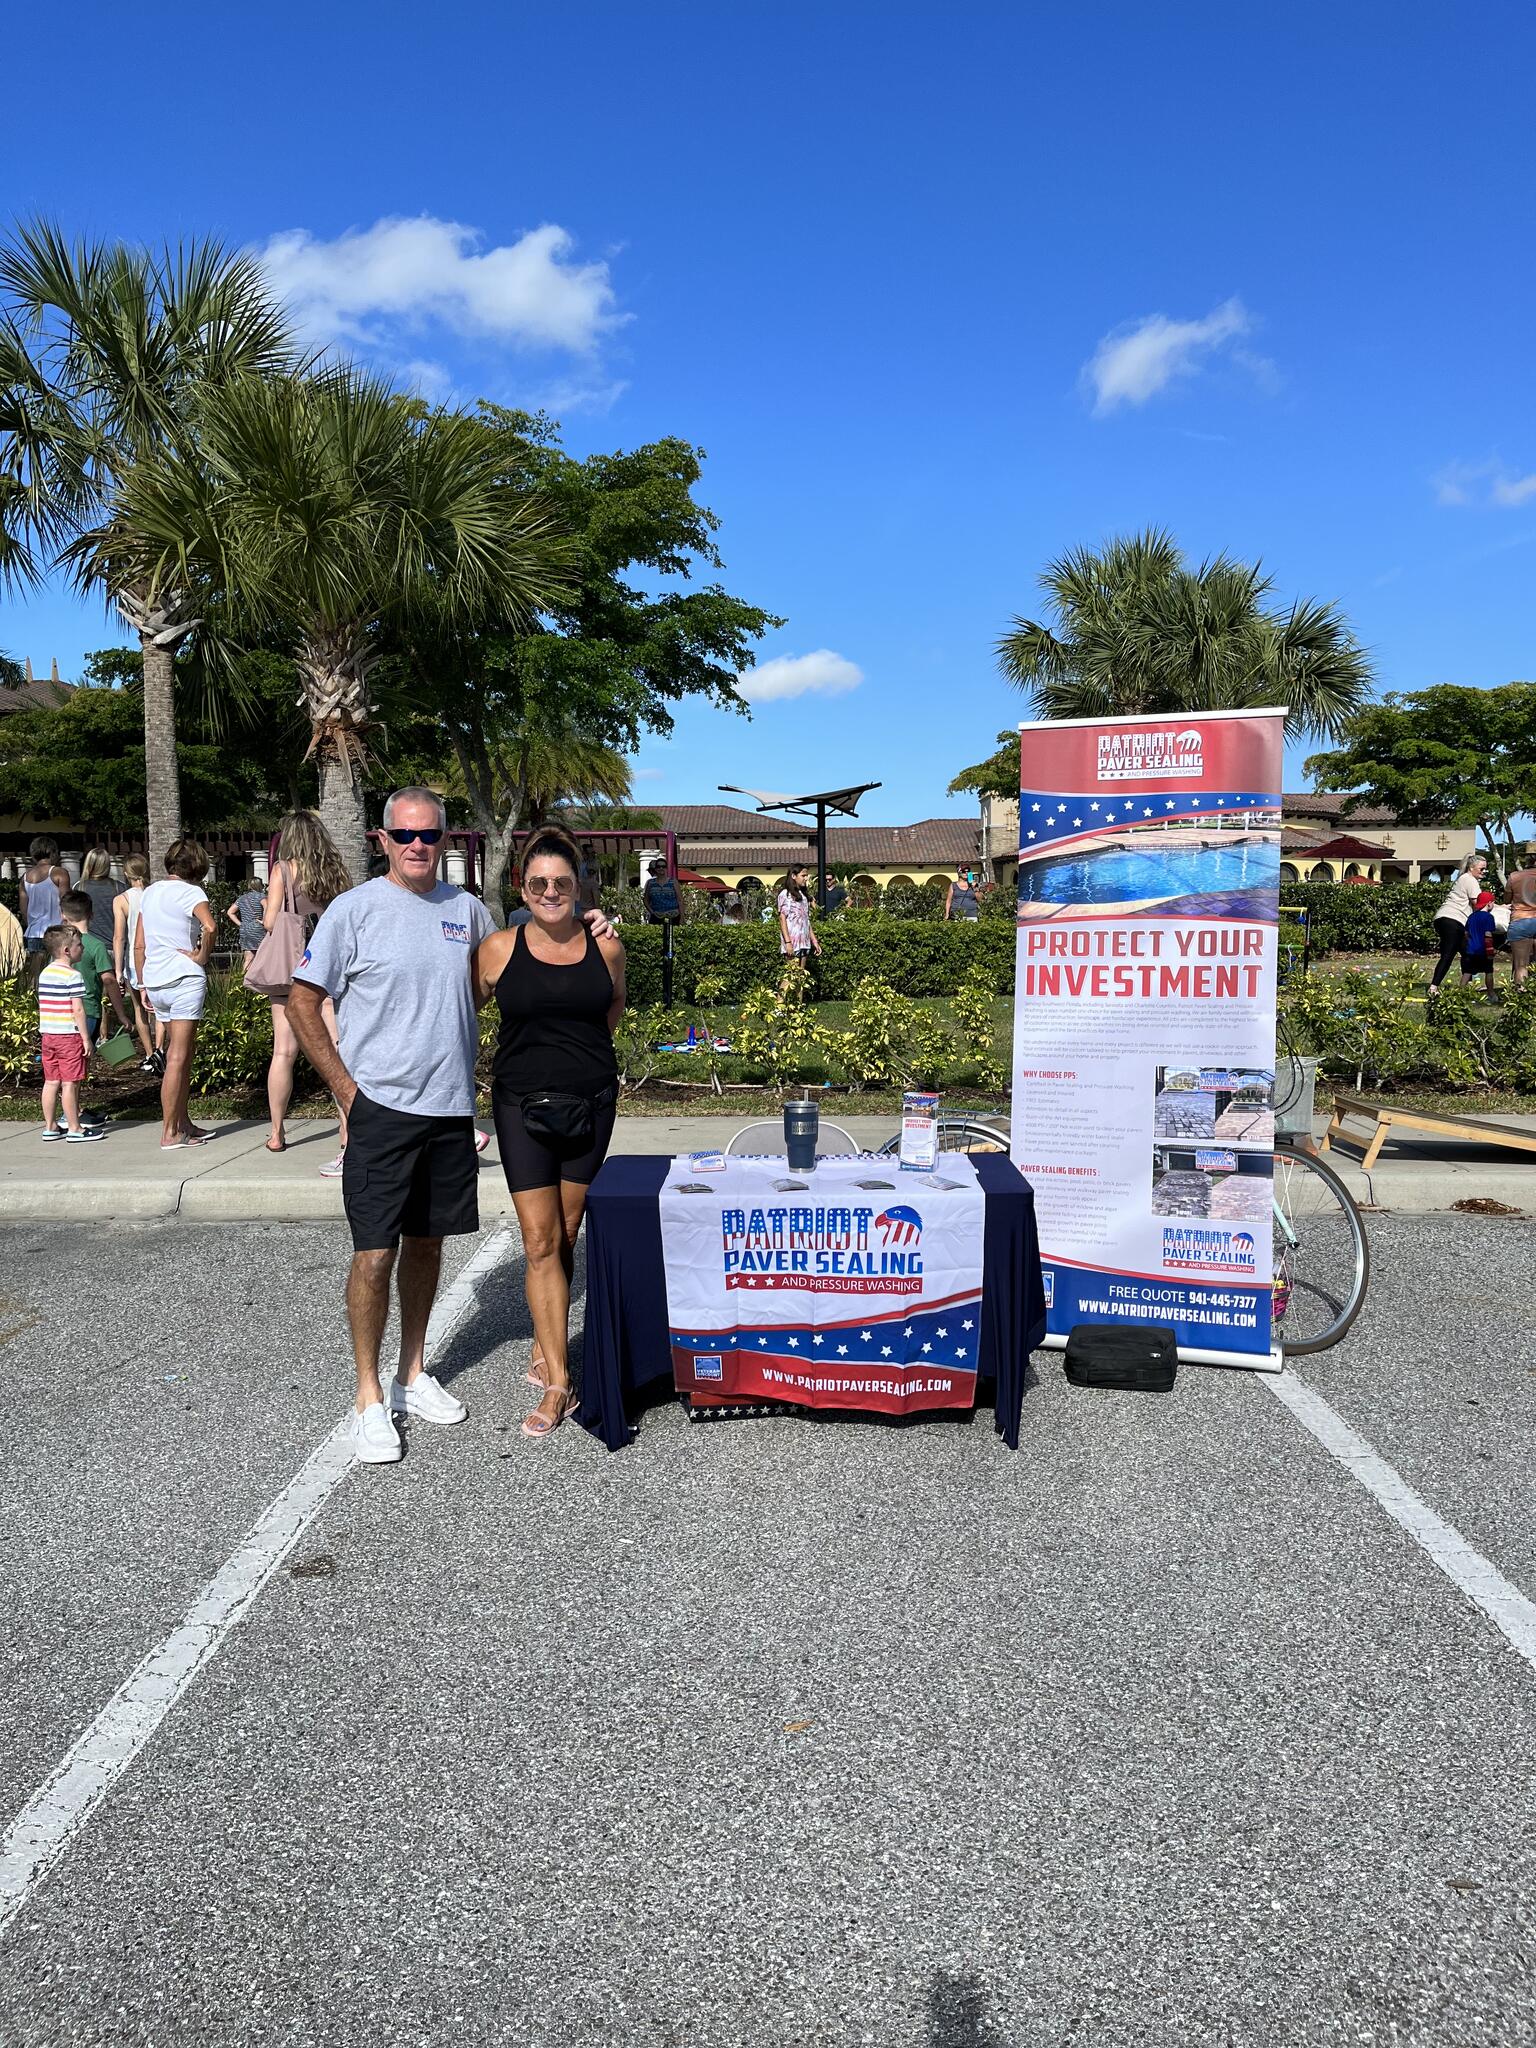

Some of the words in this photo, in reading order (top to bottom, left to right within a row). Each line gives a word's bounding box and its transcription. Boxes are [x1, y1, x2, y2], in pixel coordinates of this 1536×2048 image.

[1098, 732, 1176, 757] PATRIOT
[1098, 757, 1142, 770] PAVER
[1146, 754, 1203, 768] SEALING
[1028, 931, 1164, 957] PROTECT
[1175, 929, 1264, 956] YOUR
[1026, 965, 1263, 997] INVESTMENT
[1042, 1166, 1066, 1174] SEALING
[722, 1208, 874, 1250] PATRIOT
[1163, 1228, 1231, 1252] PATRIOT
[724, 1251, 807, 1272] PAVER
[816, 1252, 923, 1275] SEALING
[1163, 1248, 1200, 1260] PAVER
[1205, 1251, 1255, 1264] SEALING
[782, 1277, 807, 1286] AND
[810, 1279, 864, 1291] PRESSURE
[866, 1280, 920, 1291] WASHING
[1109, 1285, 1138, 1299] FREE
[1141, 1288, 1185, 1303] QUOTE
[1189, 1292, 1256, 1309] 941-445-7377
[1079, 1299, 1257, 1327] WWW.PATRIOTPAVERSEALING.COM
[762, 1368, 951, 1397] WWW.PATRIOTPAVERSEALING.COM
